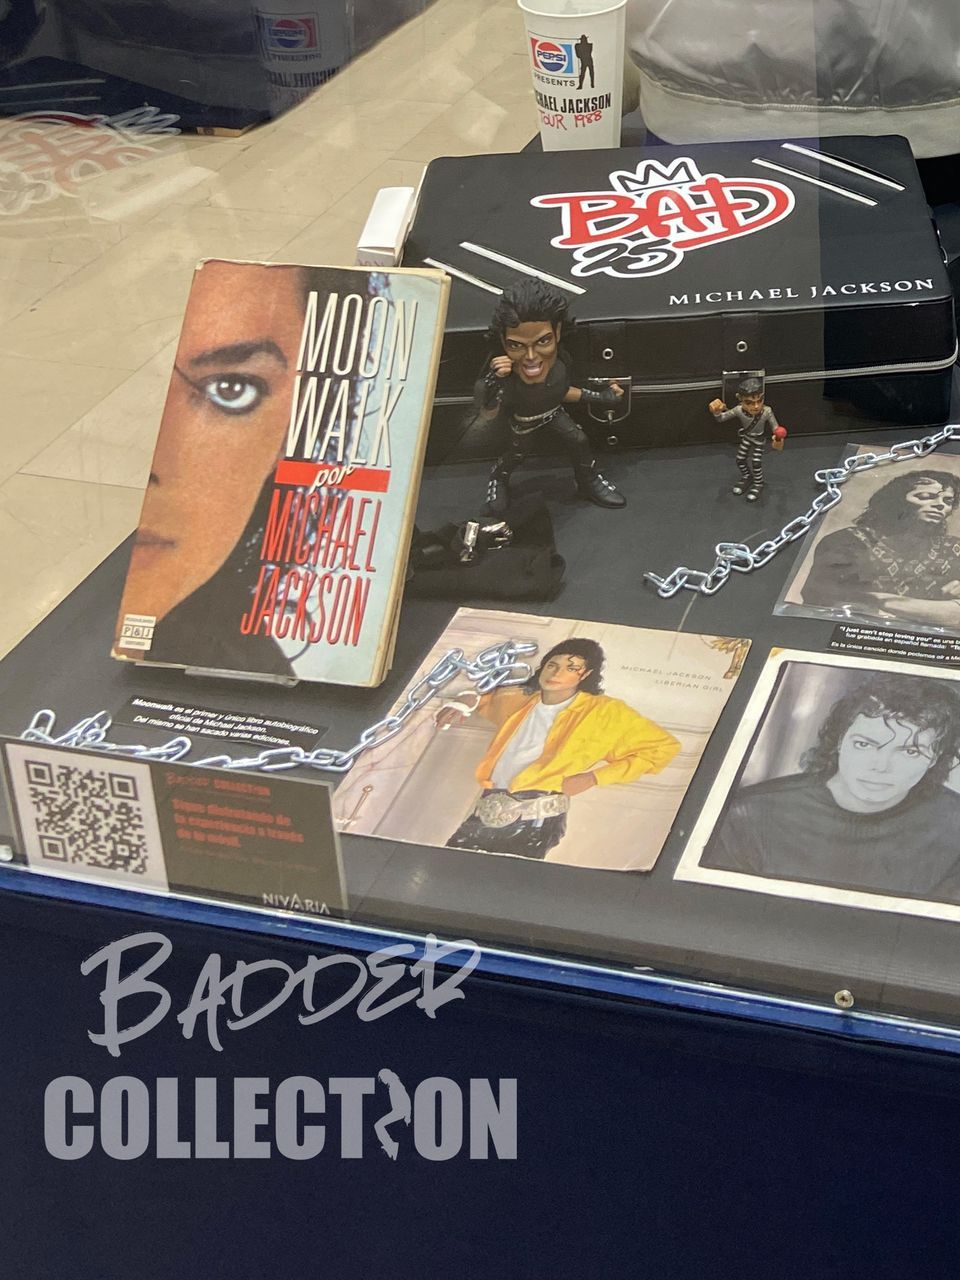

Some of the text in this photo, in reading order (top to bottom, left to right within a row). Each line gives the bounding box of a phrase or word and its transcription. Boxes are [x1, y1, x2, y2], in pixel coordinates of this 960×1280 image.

[537, 50, 566, 62] PEPSI
[534, 73, 575, 87] PRESENTS
[561, 92, 611, 113] JACKSON
[574, 110, 602, 127] 1988
[531, 174, 796, 250] BAD
[575, 237, 686, 279] 25
[669, 278, 935, 306] MICHAEL JACKSON
[297, 291, 418, 381] MOON
[286, 376, 404, 468] WALK
[311, 464, 355, 493] por
[260, 489, 382, 573] MICHAEL
[240, 565, 371, 646] JACKSON
[857, 634, 883, 643] grabada
[878, 631, 893, 639] stop
[894, 632, 914, 641] loving
[863, 645, 887, 653] canción
[907, 651, 935, 660] podemos
[621, 665, 712, 680] MICHAEL JACKSON
[655, 680, 699, 689] LIBERIAN
[132, 698, 174, 712] Moonwalk
[193, 709, 217, 720] primer
[247, 715, 263, 725] libro
[264, 719, 319, 735] autobiográfico
[169, 714, 192, 723] oficial
[204, 718, 234, 730] Michael
[134, 715, 291, 746] Del mismo han sacado varias ediciones.
